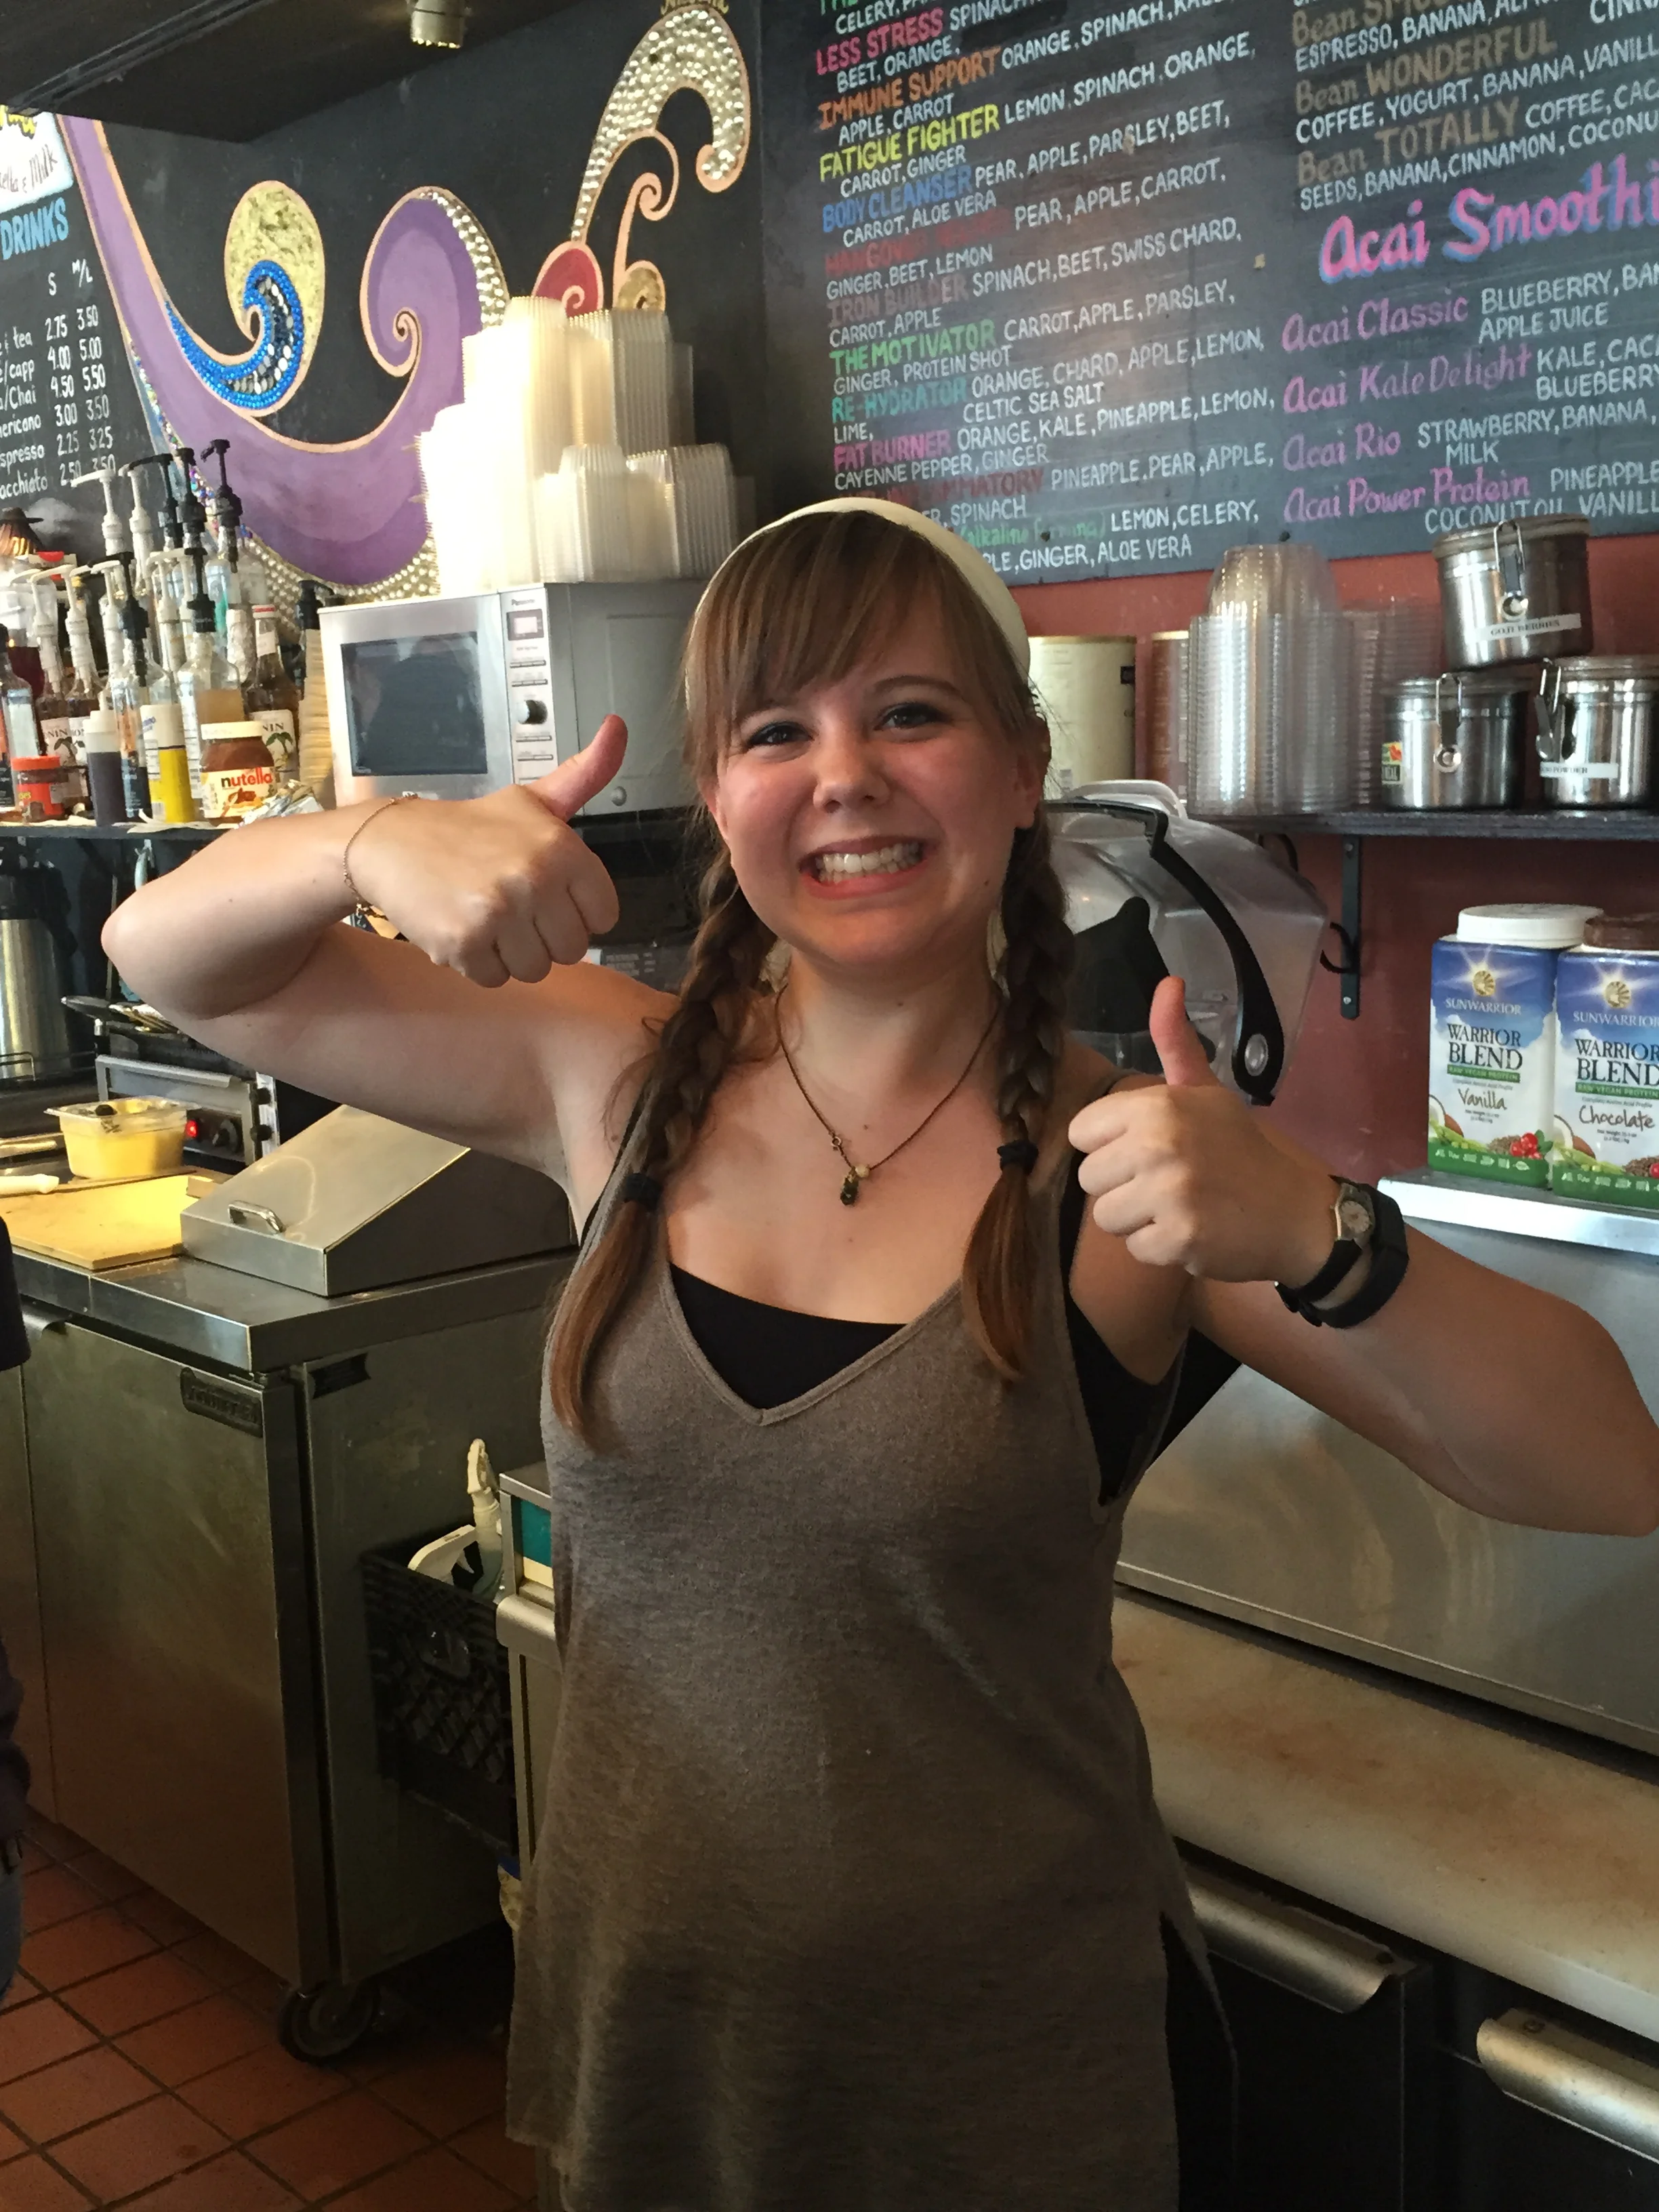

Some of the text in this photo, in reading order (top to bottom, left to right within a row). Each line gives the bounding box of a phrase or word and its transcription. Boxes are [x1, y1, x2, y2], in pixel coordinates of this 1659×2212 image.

[816, 36, 861, 75] LESS
[867, 7, 944, 58] STRESS
[1291, 7, 1357, 47] Bean
[1295, 24, 1398, 73] ESPRESSO,
[837, 35, 960, 94] BEET, ORANGE,
[1295, 18, 1559, 115] Bean WONDERFUL
[818, 78, 903, 131] IMMUNE
[909, 45, 1002, 102] SUPPORT
[819, 132, 902, 183] FATIGUE
[907, 104, 1000, 156] FIGHTER
[1165, 31, 1255, 79] ORANGE,
[893, 92, 954, 130] CARROT
[1296, 102, 1385, 144] COFFEE,
[1385, 78, 1479, 118] YOGURT,
[1482, 55, 1584, 98] BANANA,
[1296, 148, 1368, 187] Bean
[1374, 96, 1519, 167] TOTALLY
[1525, 88, 1612, 129] COFFEE,
[1300, 110, 1659, 211] SEEDS, BANANA, CINNAMON, COCONU
[823, 198, 865, 233] BODY
[868, 165, 972, 220] CLEANSER
[1027, 141, 1088, 175] APPLE,
[1176, 100, 1230, 136] BEET,
[840, 144, 966, 198] CARROT, GINGER
[1015, 198, 1071, 231] PEAR,
[1074, 181, 1141, 218] APPLE,
[1141, 157, 1227, 200] CARROT,
[0, 197, 69, 261] DRINKS
[843, 215, 910, 247] CARROT,
[912, 202, 951, 229] ALOE
[954, 189, 997, 217] VERA
[972, 258, 1057, 297] SPINACH,
[1057, 245, 1108, 279] BEET,
[1111, 231, 1166, 267] SWISS
[1169, 217, 1242, 252] CHARD,
[1319, 199, 1430, 284] Acai
[47, 272, 57, 296] S
[826, 271, 888, 301] GINGER,
[888, 259, 934, 288] BEET,
[936, 243, 994, 275] LEMON
[13, 326, 33, 349] tea
[45, 314, 68, 342] 2.75
[76, 304, 98, 331] 3.50
[829, 306, 943, 348] CARROT, APPLE
[829, 279, 1235, 375] THE MOTIVATOR CARROT, APPLE, PARSLEY,
[1281, 306, 1351, 353] Acai
[1357, 287, 1469, 340] Classic
[1481, 269, 1619, 314] BLUEBERRY,
[1478, 302, 1608, 344] APPLE JUICE
[47, 335, 102, 370] 4.00 5.00
[833, 344, 1013, 396] GINGER, PROTEIN SHOT
[971, 366, 1050, 398] ORANGE,
[1052, 352, 1124, 384] CHARD,
[1128, 338, 1195, 371] APPLE,
[50, 363, 106, 398] 4.50 5.50
[1283, 371, 1349, 413] Acai
[1359, 362, 1425, 402] Kale
[1429, 342, 1532, 392] Delight
[1536, 341, 1605, 373] KALE,
[54, 403, 78, 427] 3.00
[834, 382, 1107, 445] LIME, CELTIC SEA SALT
[834, 387, 1275, 474] FAT BURNER ORANGE, KALE, PINEAPPLE, LEMON,
[1282, 397, 1656, 472] Acai Rio STRAWBERRY, BANANA,
[0, 445, 45, 475] spresso
[834, 464, 907, 491] CAYENNE
[912, 453, 979, 481] PEPPER,
[982, 443, 1049, 470] GINGER
[1149, 451, 1206, 478] PEAR,
[1206, 442, 1273, 472] APPLE,
[1446, 441, 1500, 467] MILK
[0, 468, 48, 499] acchiato
[1284, 484, 1341, 523] Acai
[1347, 478, 1427, 517] Power
[950, 494, 1027, 527] SPINACH
[1111, 499, 1259, 533] LEMON, CELERY,
[1425, 499, 1530, 535] COCONUT
[1020, 533, 1192, 569] GINGER, ALOE VERA
[221, 766, 273, 787] nutella
[1445, 997, 1521, 1015] SUNWARRIOR
[1447, 1023, 1521, 1047] WARRIOR
[1449, 1041, 1523, 1070] BLEND
[1574, 1038, 1659, 1061] WARRIOR
[1577, 1057, 1659, 1086] BLEND
[1458, 1088, 1507, 1110] Vanilla
[1578, 1105, 1655, 1132] Chocolate
